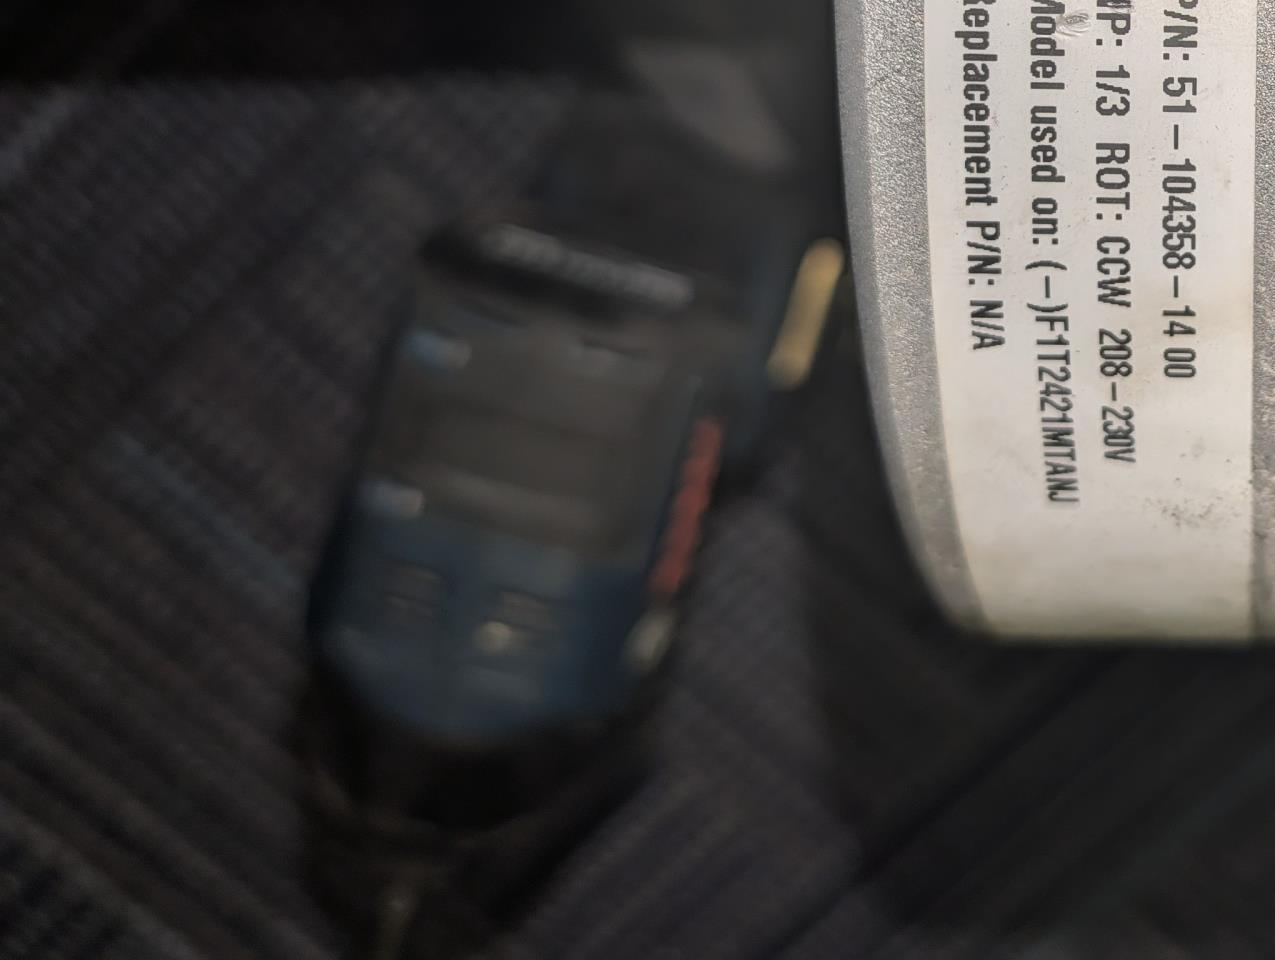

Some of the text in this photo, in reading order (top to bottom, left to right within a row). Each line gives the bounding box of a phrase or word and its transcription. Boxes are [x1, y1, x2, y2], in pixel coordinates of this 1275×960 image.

[1096, 64, 1130, 117] 1/3
[1031, 105, 1065, 183] used
[1096, 143, 1130, 220] ROT:
[966, 220, 1002, 286] P/N:
[1032, 197, 1059, 245] on:
[1097, 236, 1132, 308] CCW
[970, 300, 1005, 350] N/A
[1099, 328, 1136, 463] 208-230V
